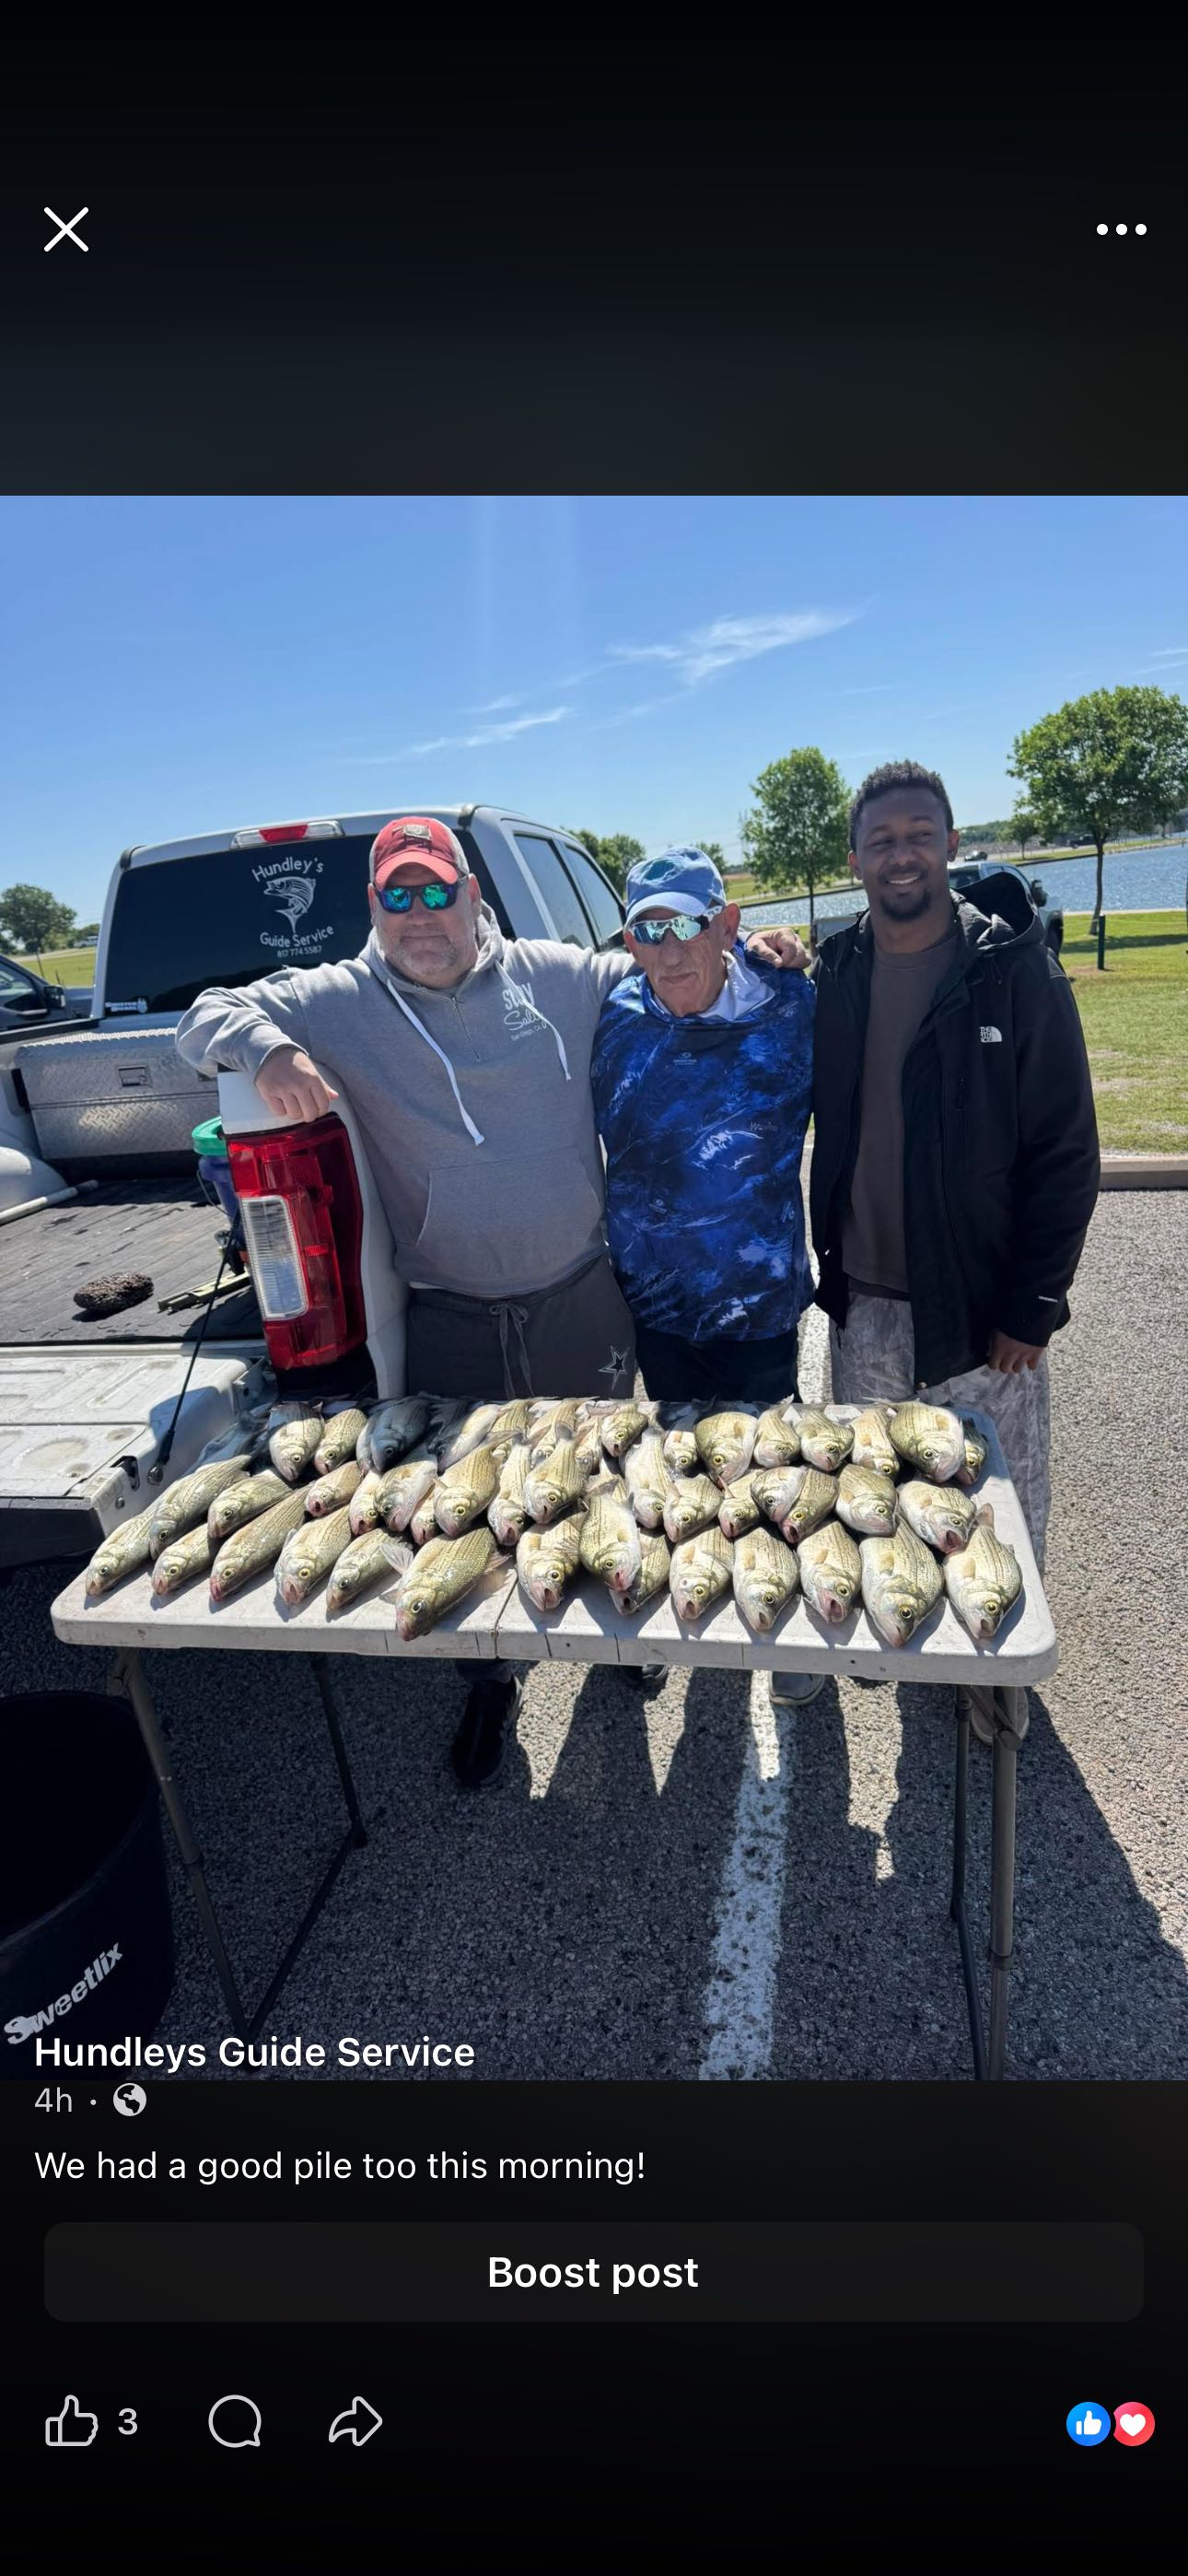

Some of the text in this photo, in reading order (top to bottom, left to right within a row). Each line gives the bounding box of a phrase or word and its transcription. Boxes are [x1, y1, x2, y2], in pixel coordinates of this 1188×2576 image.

[250, 856, 324, 882] Hundley's
[260, 925, 334, 948] Guide Service
[4, 1942, 123, 2044] Sweetlix
